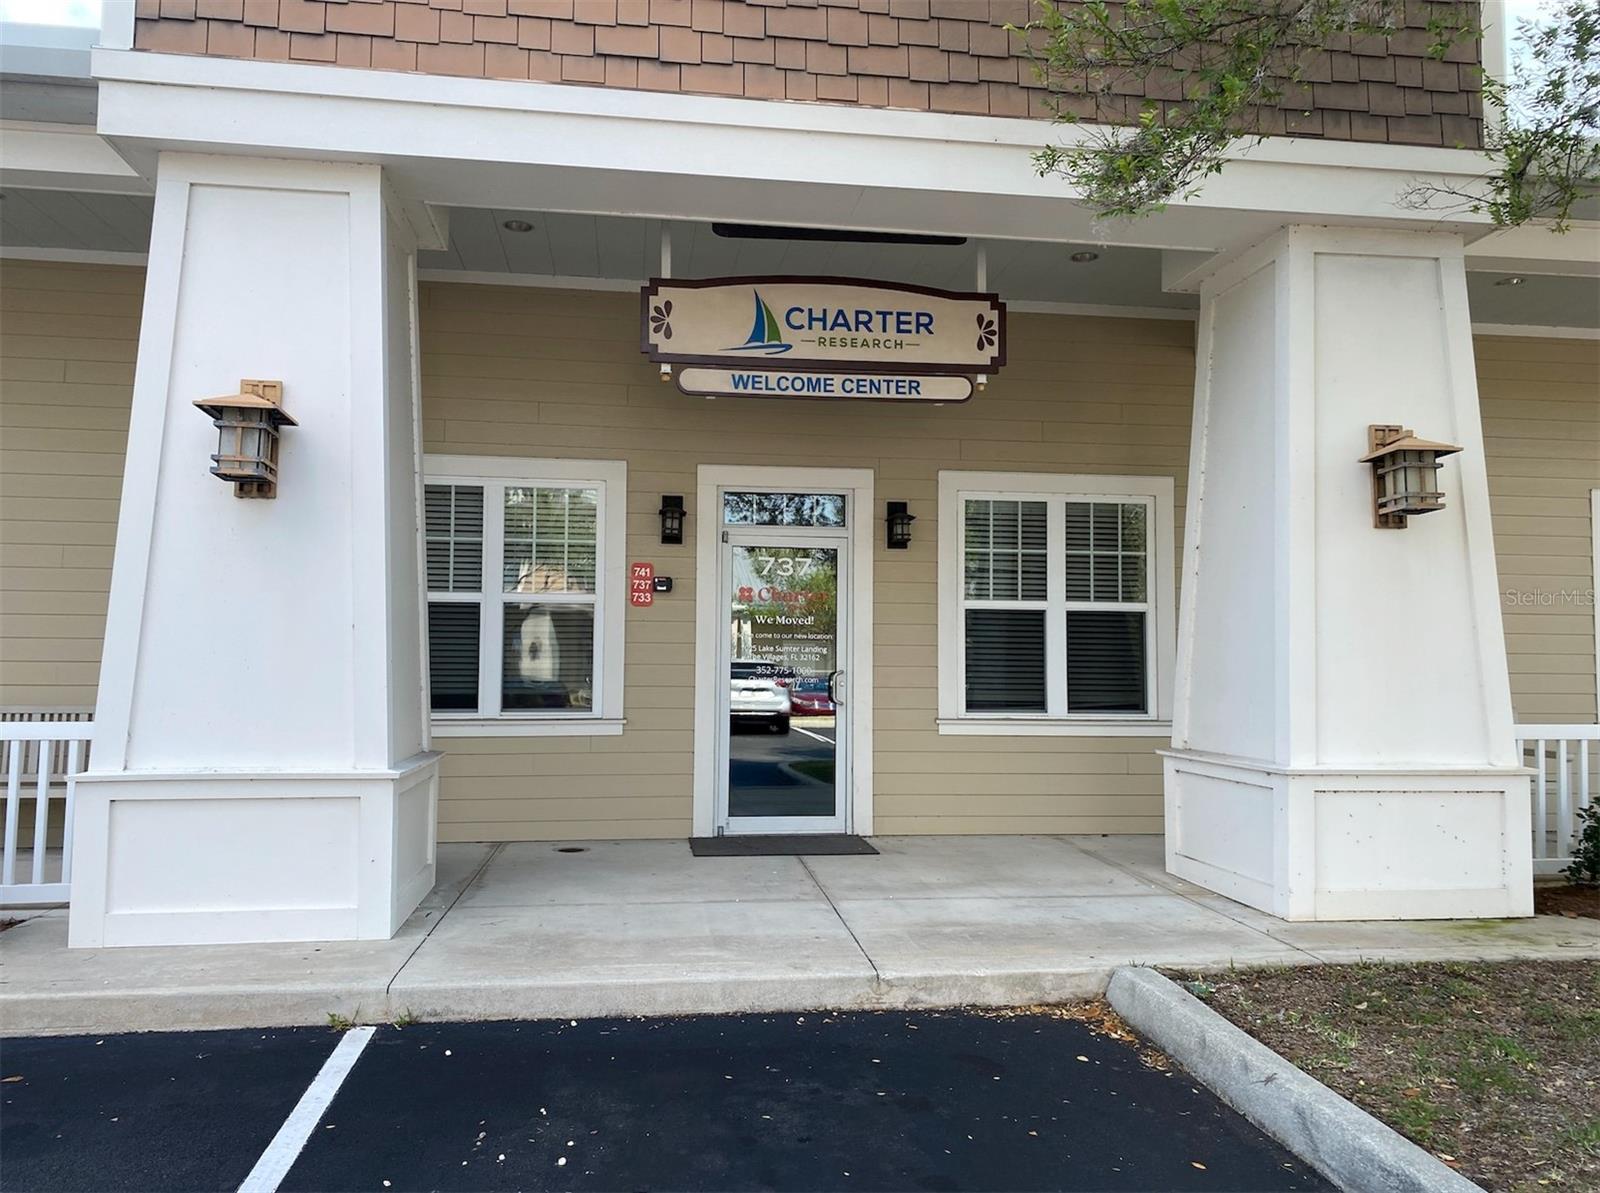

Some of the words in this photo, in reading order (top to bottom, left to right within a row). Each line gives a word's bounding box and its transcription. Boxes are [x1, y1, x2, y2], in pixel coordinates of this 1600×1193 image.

[785, 306, 934, 335] CHARTER
[817, 336, 904, 350] RESEARCH
[731, 374, 835, 393] WELCOME
[841, 378, 921, 396] CENTER
[758, 556, 812, 576] 737
[633, 567, 651, 577] 741
[633, 580, 651, 590] 737
[632, 592, 652, 602] 733
[755, 615, 774, 625] We
[776, 615, 815, 625] Moved!
[755, 632, 772, 640] come
[773, 632, 781, 640] to
[781, 632, 793, 640] our
[758, 645, 774, 653] Lake
[775, 645, 801, 654] Sumter
[800, 646, 828, 656] Landing
[790, 654, 799, 662] FL
